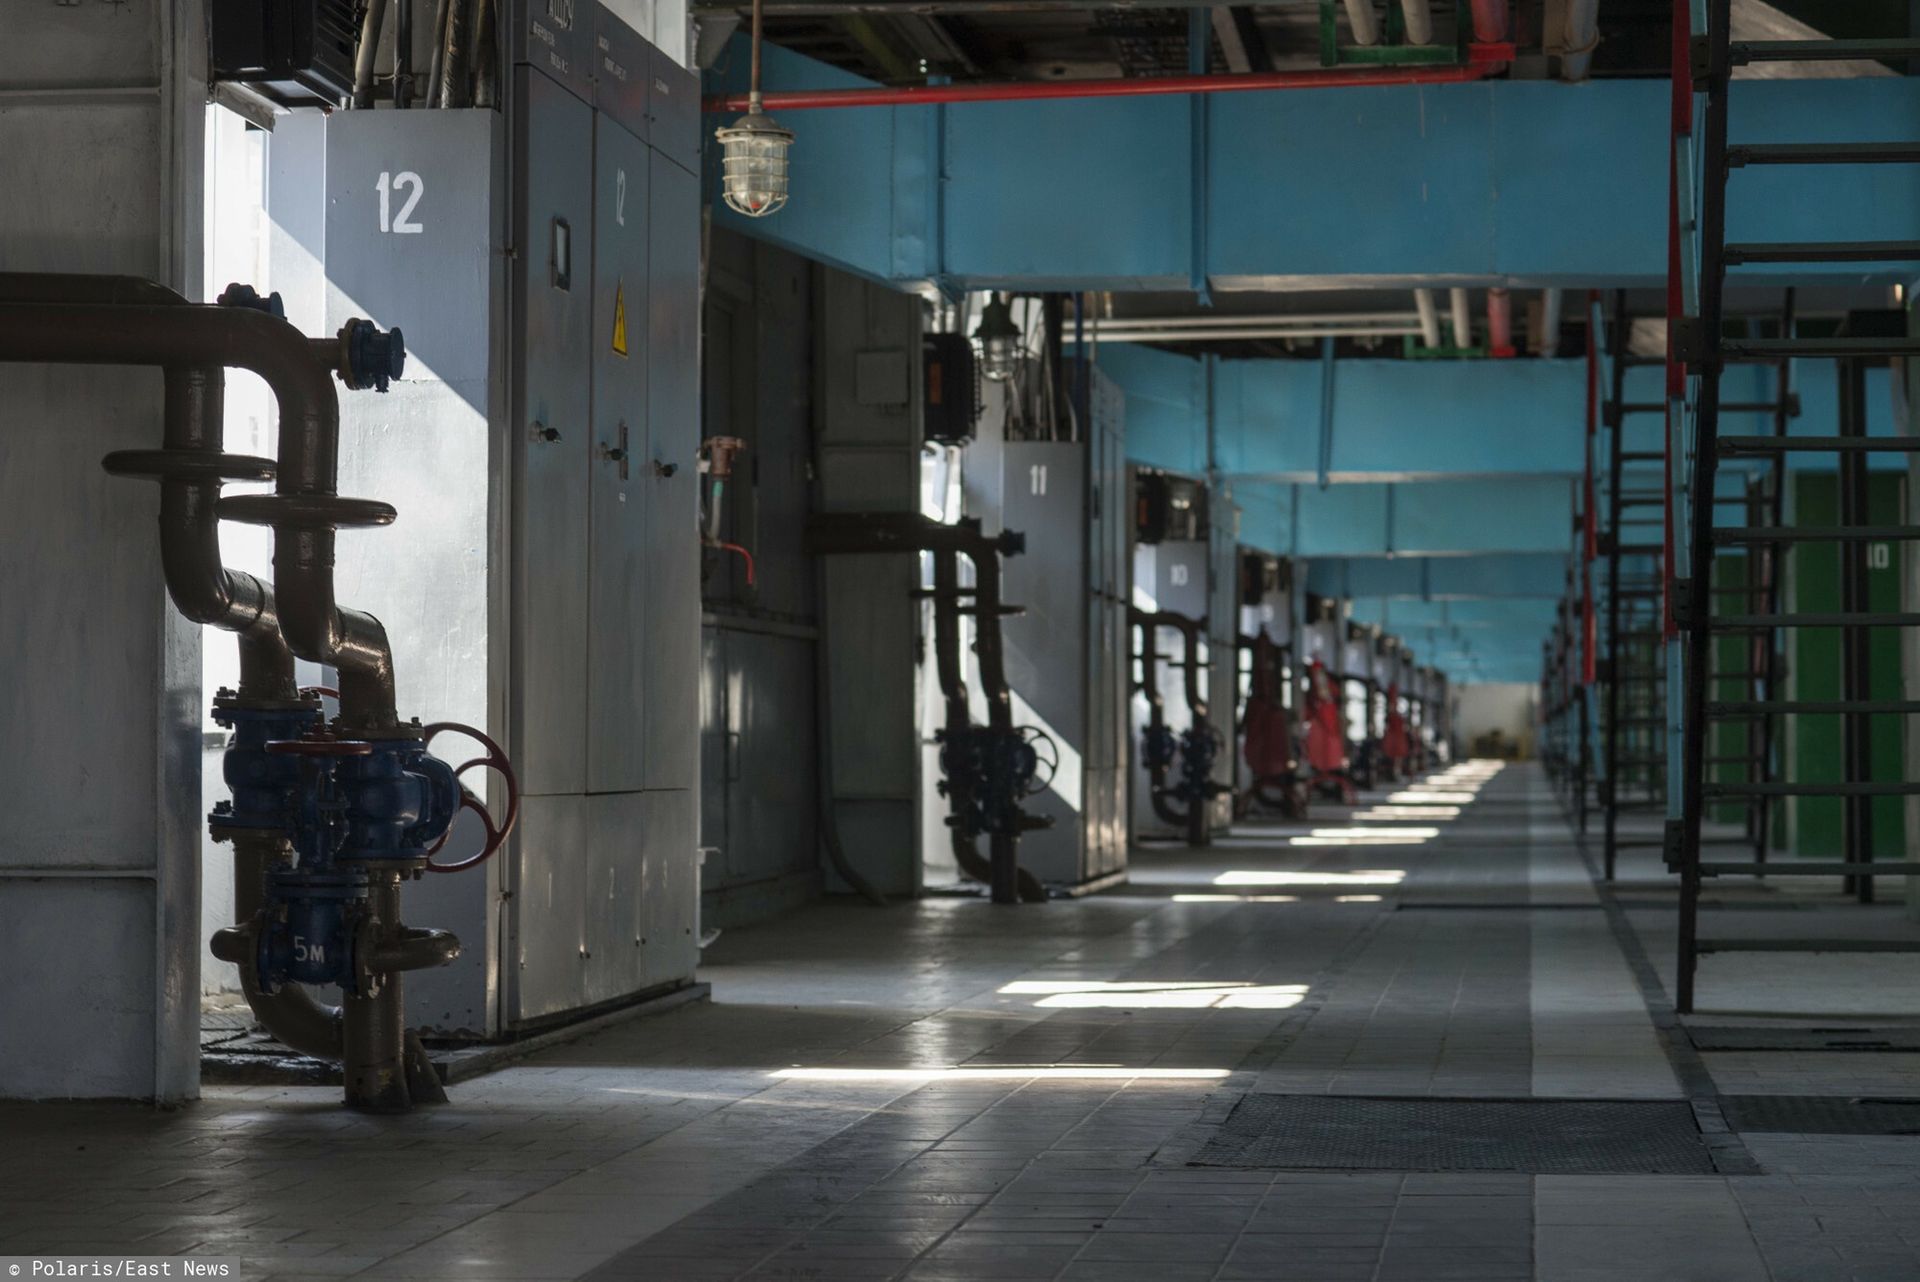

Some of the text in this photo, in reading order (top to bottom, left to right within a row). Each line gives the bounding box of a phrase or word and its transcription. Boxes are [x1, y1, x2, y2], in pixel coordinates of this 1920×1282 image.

[375, 171, 424, 233] 12
[616, 167, 626, 227] 12
[1030, 465, 1047, 495] 11
[1866, 543, 1889, 569] 10
